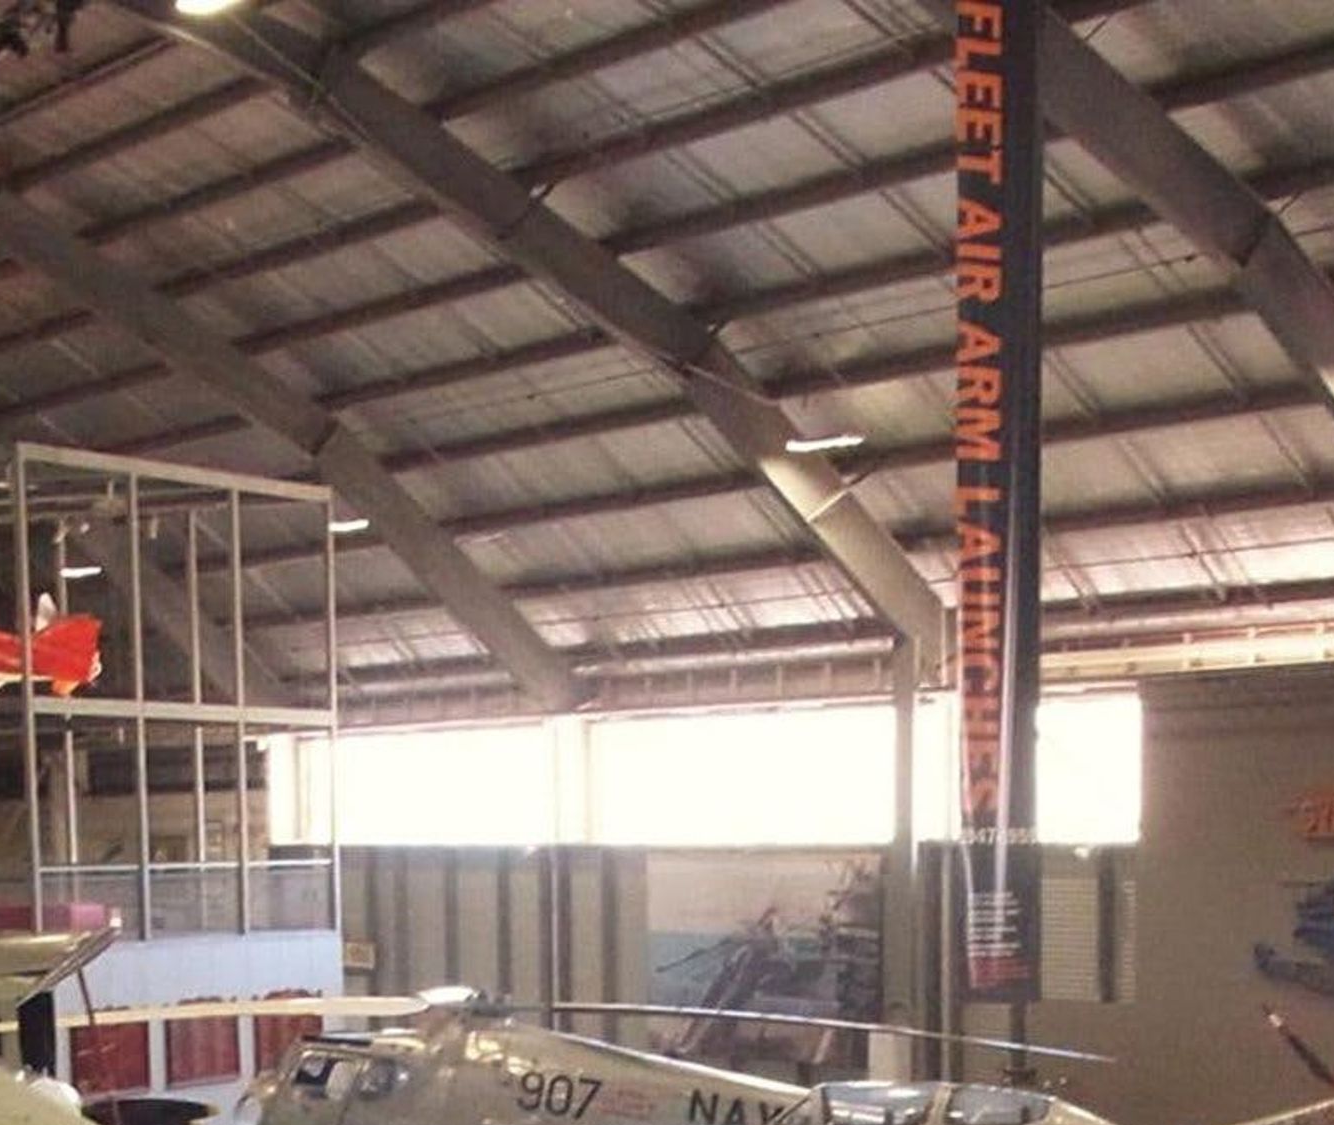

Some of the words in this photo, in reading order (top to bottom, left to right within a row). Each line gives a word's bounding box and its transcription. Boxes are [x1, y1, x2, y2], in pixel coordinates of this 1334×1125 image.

[954, 1, 1004, 184] FLEET
[954, 203, 1004, 306] AIR
[952, 326, 1004, 463] ARM
[956, 487, 1005, 814] LAUNCHES
[516, 1071, 603, 1121] 907
